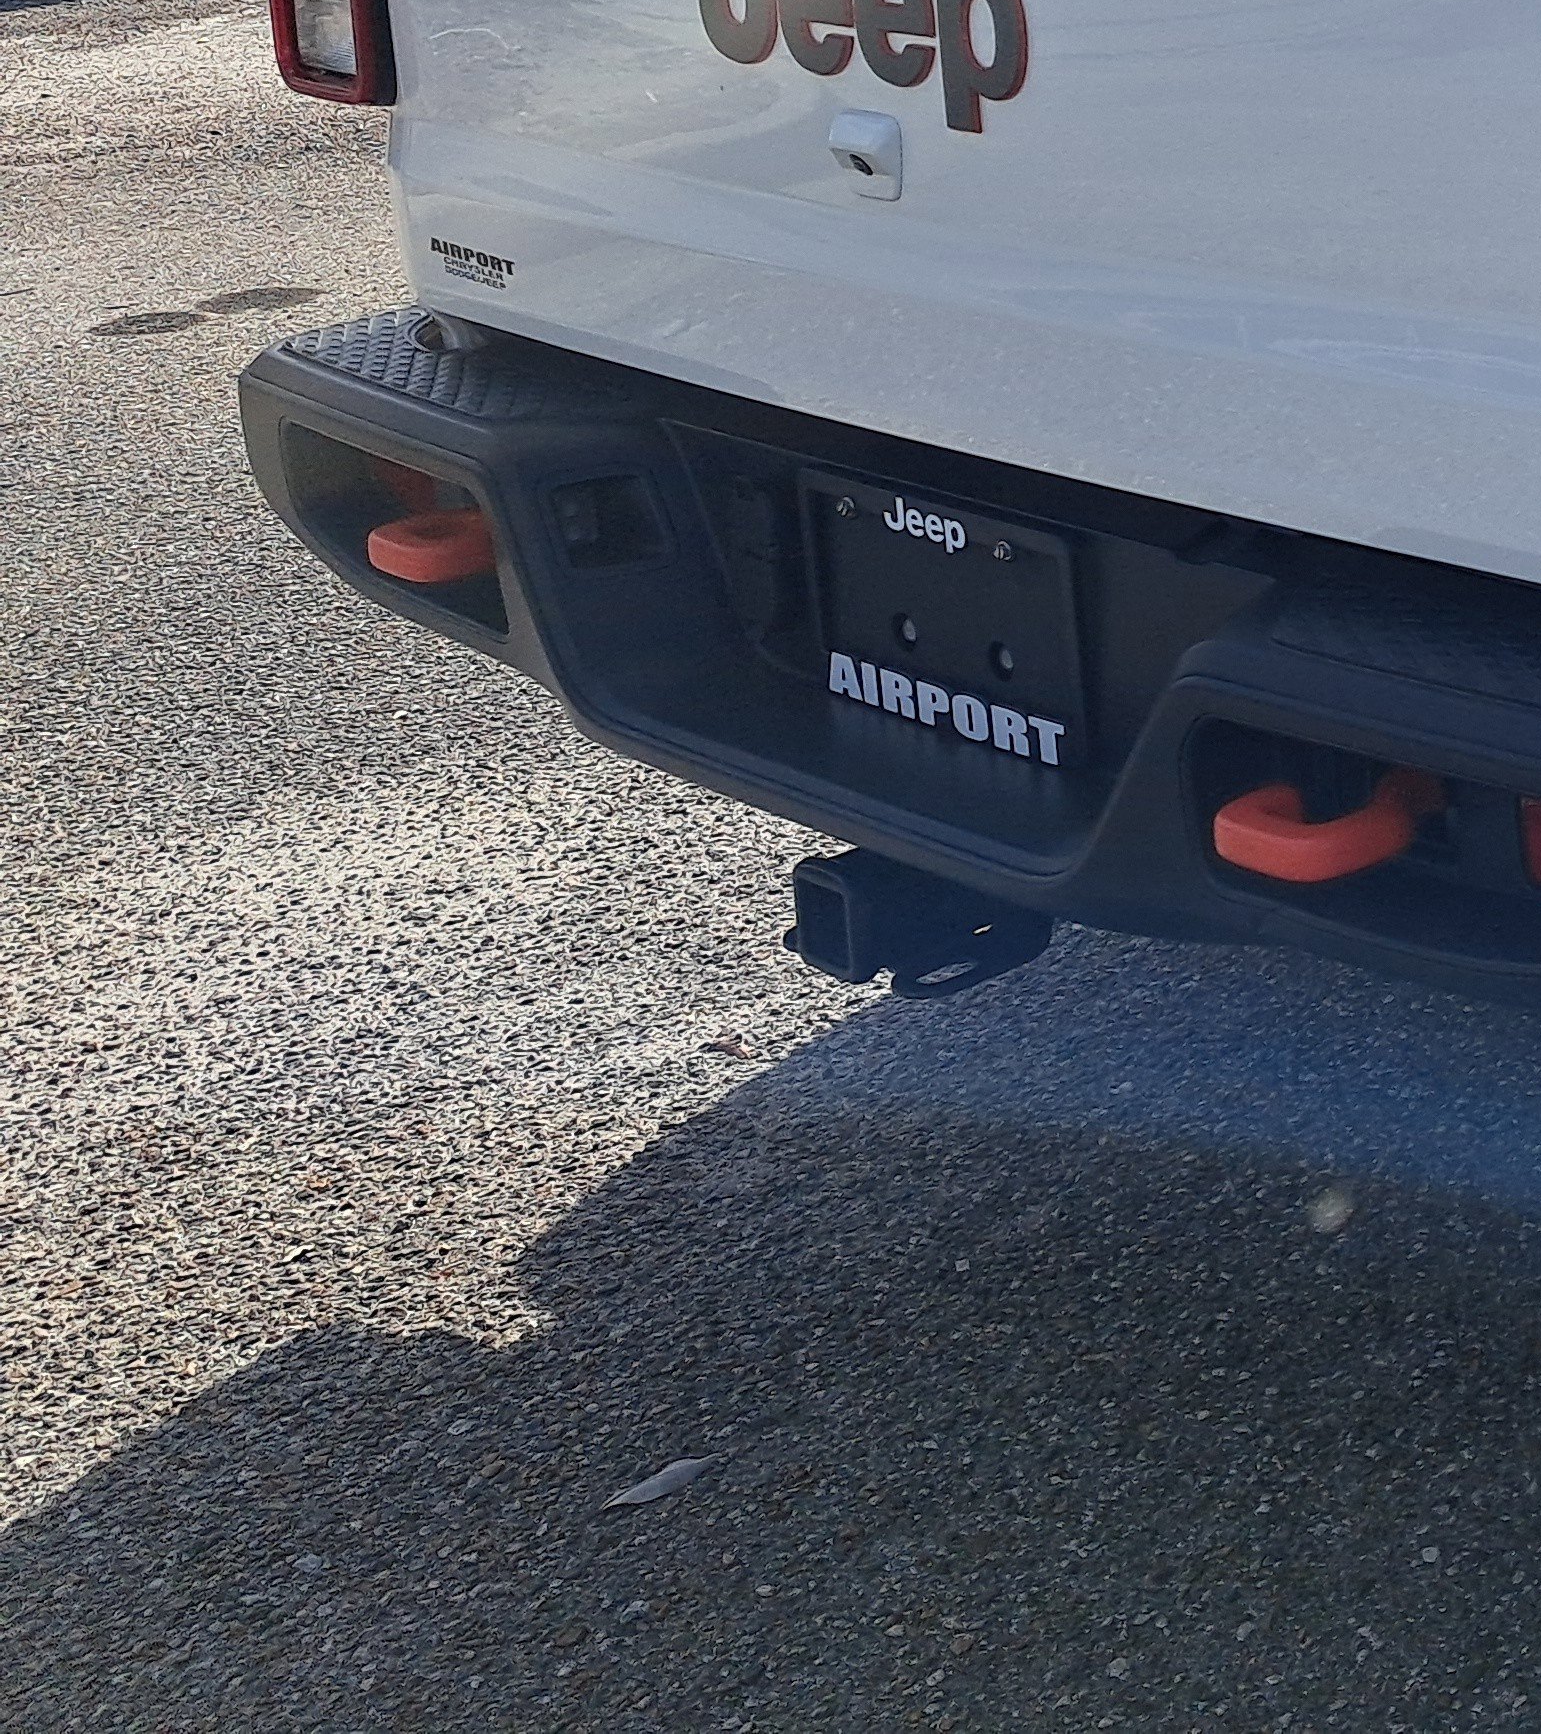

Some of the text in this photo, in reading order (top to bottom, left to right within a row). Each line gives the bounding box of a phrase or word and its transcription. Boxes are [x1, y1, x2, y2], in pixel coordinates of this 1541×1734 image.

[430, 236, 516, 276] AIRPORT
[443, 256, 504, 282] CHRYSLER
[884, 496, 967, 554] Jeep
[828, 651, 1066, 766] AIRPORT
